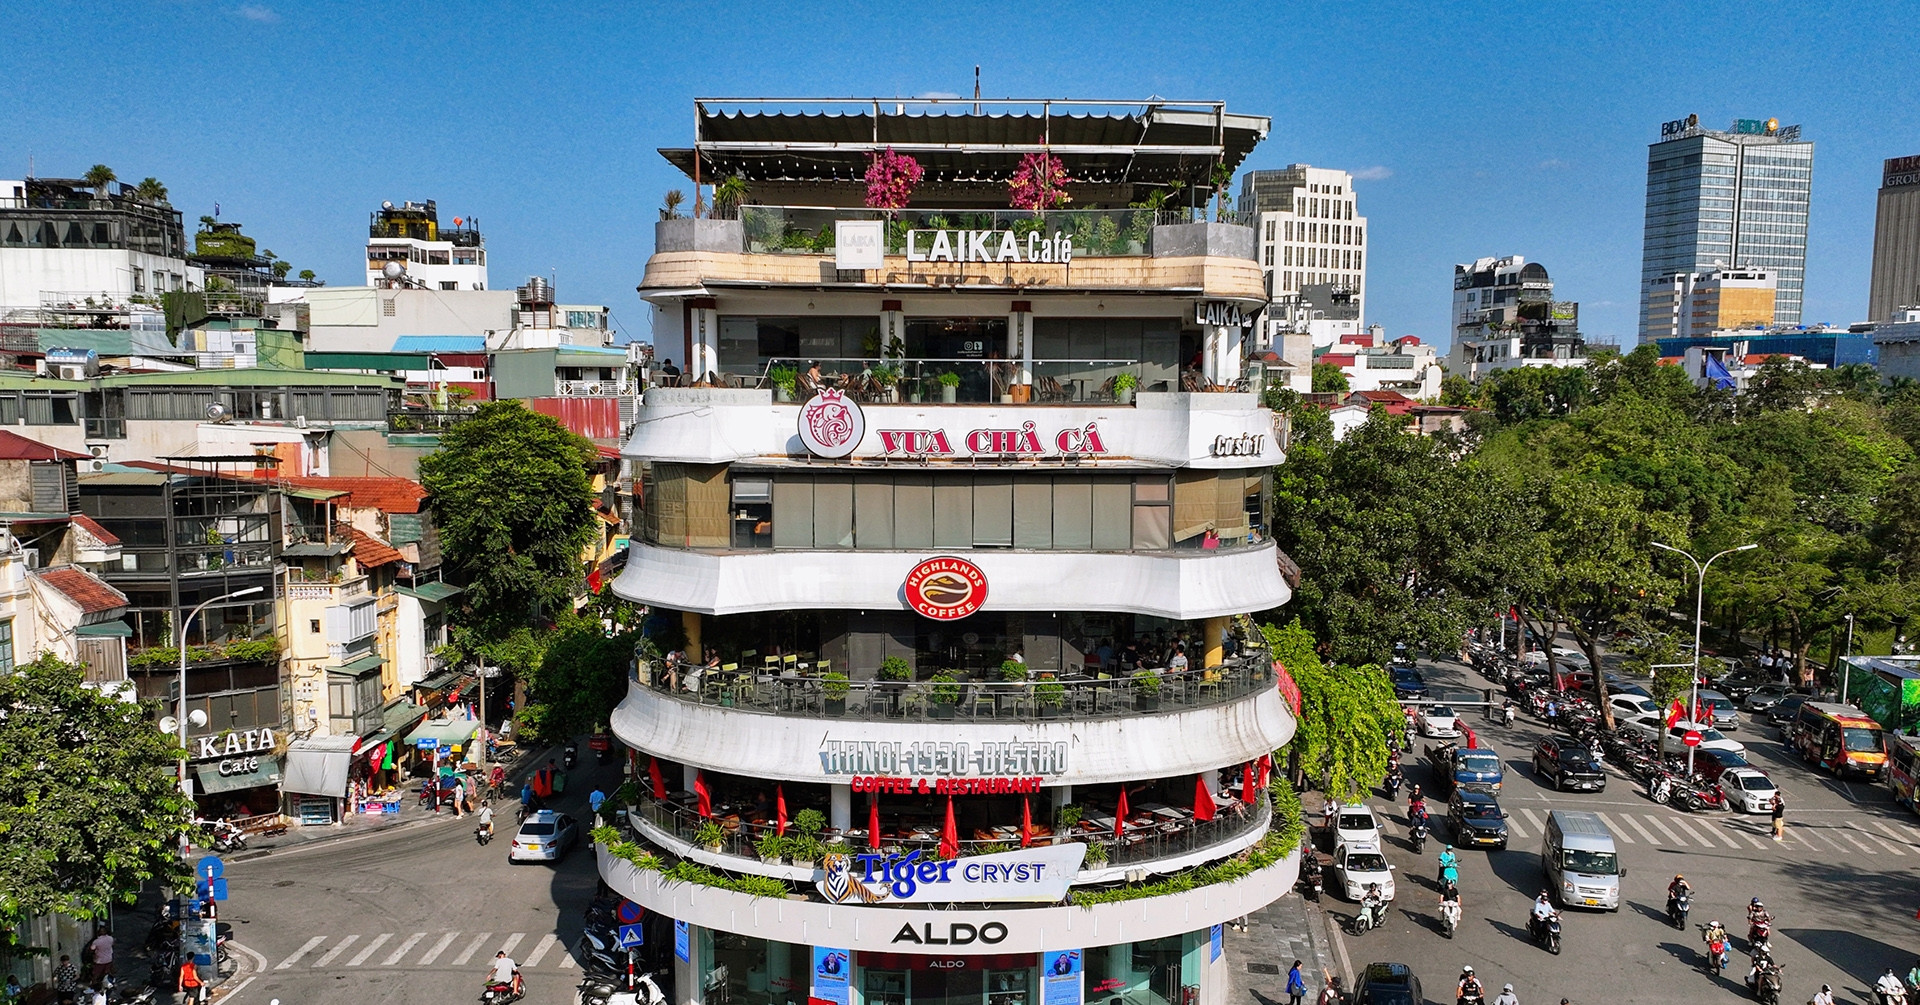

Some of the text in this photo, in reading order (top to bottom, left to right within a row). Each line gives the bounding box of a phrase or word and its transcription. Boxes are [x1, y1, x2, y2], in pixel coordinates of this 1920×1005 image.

[1661, 118, 1688, 136] BIDV
[1737, 119, 1767, 134] BIDV
[907, 229, 1073, 263] LAIKA Café
[1196, 302, 1241, 326] LAIKA
[876, 420, 1108, 454] VUA CHẢ CÁ
[909, 561, 984, 588] HIGHLANDS
[918, 601, 976, 618] COFFEE
[198, 728, 276, 759] KAFA
[219, 757, 259, 776] Café
[826, 740, 903, 774] HANOI
[981, 741, 1068, 776] BISTRO
[851, 776, 1043, 795] COFFEE & RESTAURANT
[856, 850, 957, 898] Tiger
[891, 921, 1008, 945] ALDO
[929, 960, 965, 968] ALDO
